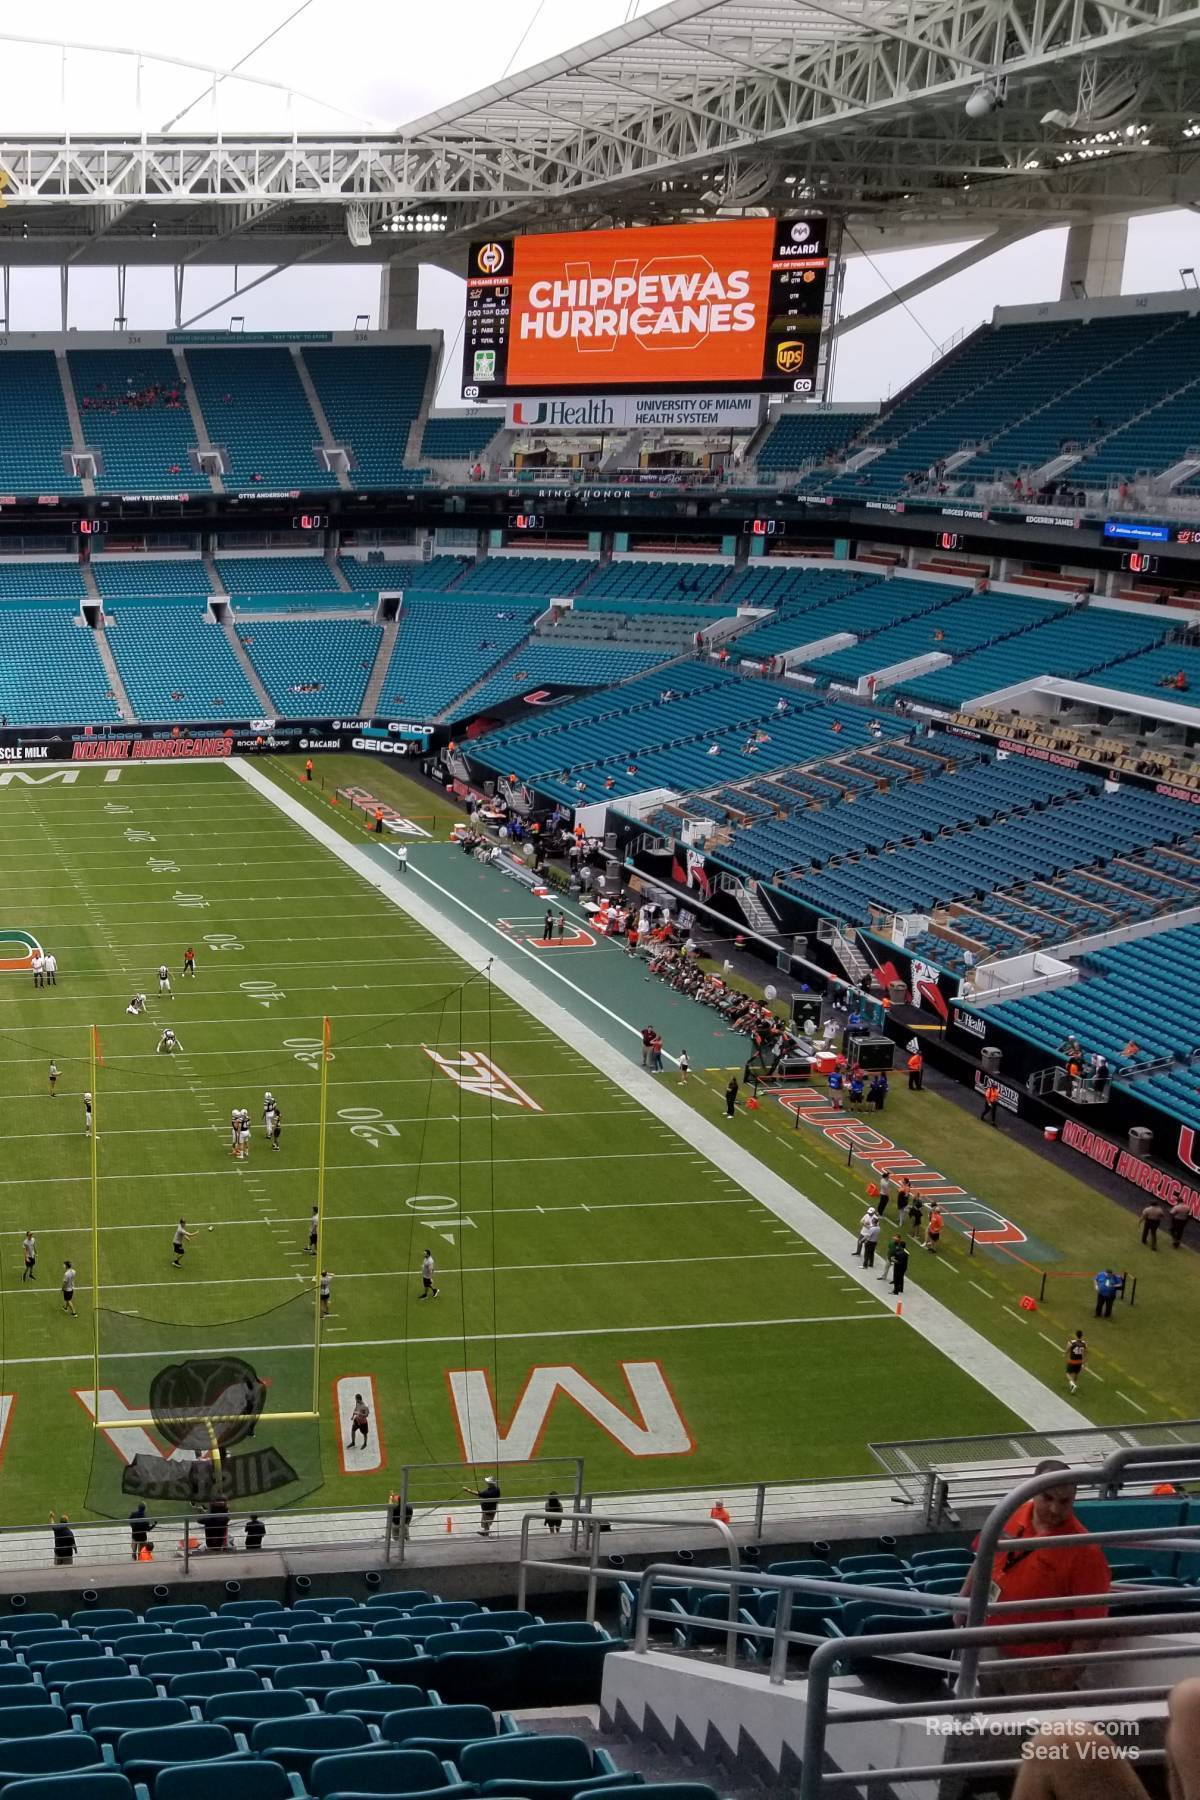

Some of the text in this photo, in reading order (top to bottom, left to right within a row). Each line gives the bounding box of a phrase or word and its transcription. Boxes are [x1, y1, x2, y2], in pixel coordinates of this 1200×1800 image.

[779, 240, 820, 256] BACARDÍ
[528, 270, 750, 308] CHIPPEWAS
[520, 302, 756, 340] HURRICANES
[778, 350, 801, 368] ups
[795, 380, 810, 390] CC
[465, 388, 478, 396] CC
[636, 398, 752, 411] UNIVERSITY OF MIAMI
[635, 412, 719, 424] HEALTH SYSTEM
[538, 489, 631, 499] RING HONOR
[342, 719, 372, 729] BACARDÍ
[388, 722, 435, 735] GEICO
[71, 738, 234, 760] MIAMI HURRICANES
[309, 738, 341, 748] BACARDÍ
[351, 738, 408, 754] GEICO
[23, 746, 48, 759] MILK
[1061, 1119, 1119, 1170] MIAMI
